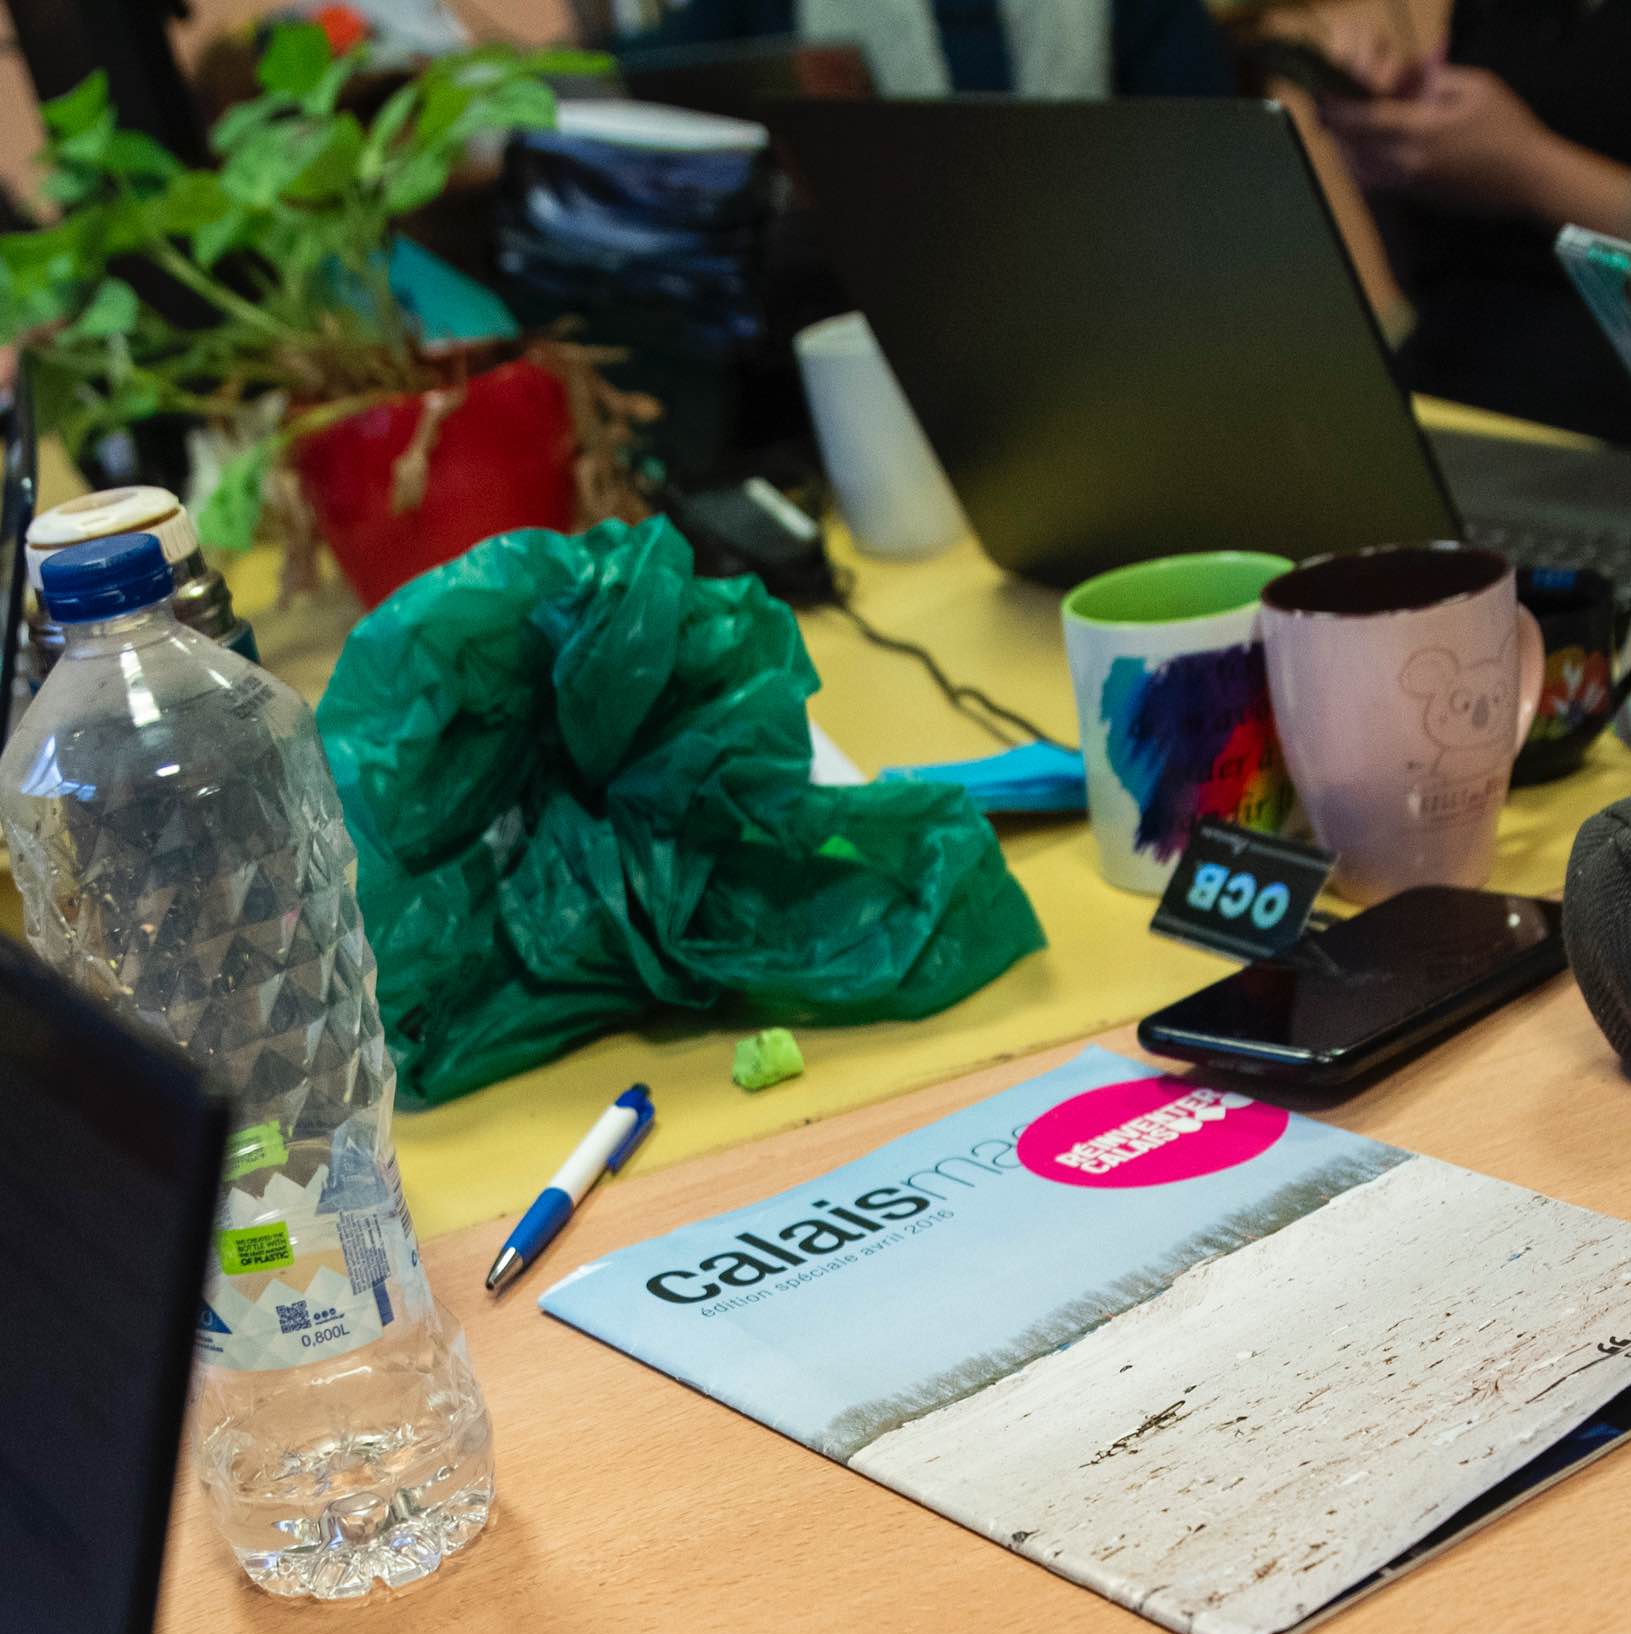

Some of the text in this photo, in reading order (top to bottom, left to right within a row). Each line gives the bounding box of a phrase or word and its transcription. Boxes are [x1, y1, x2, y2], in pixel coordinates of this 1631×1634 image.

[1186, 862, 1291, 930] OCB
[1054, 1088, 1220, 1169] RÉINVENTER
[1080, 1124, 1180, 1175] CALAIS
[646, 1123, 1026, 1304] calaisma
[240, 1250, 290, 1266] OF PLASTIC
[701, 1208, 956, 1319] édition spéciale avril 2016
[301, 1322, 351, 1349] 0,800L
